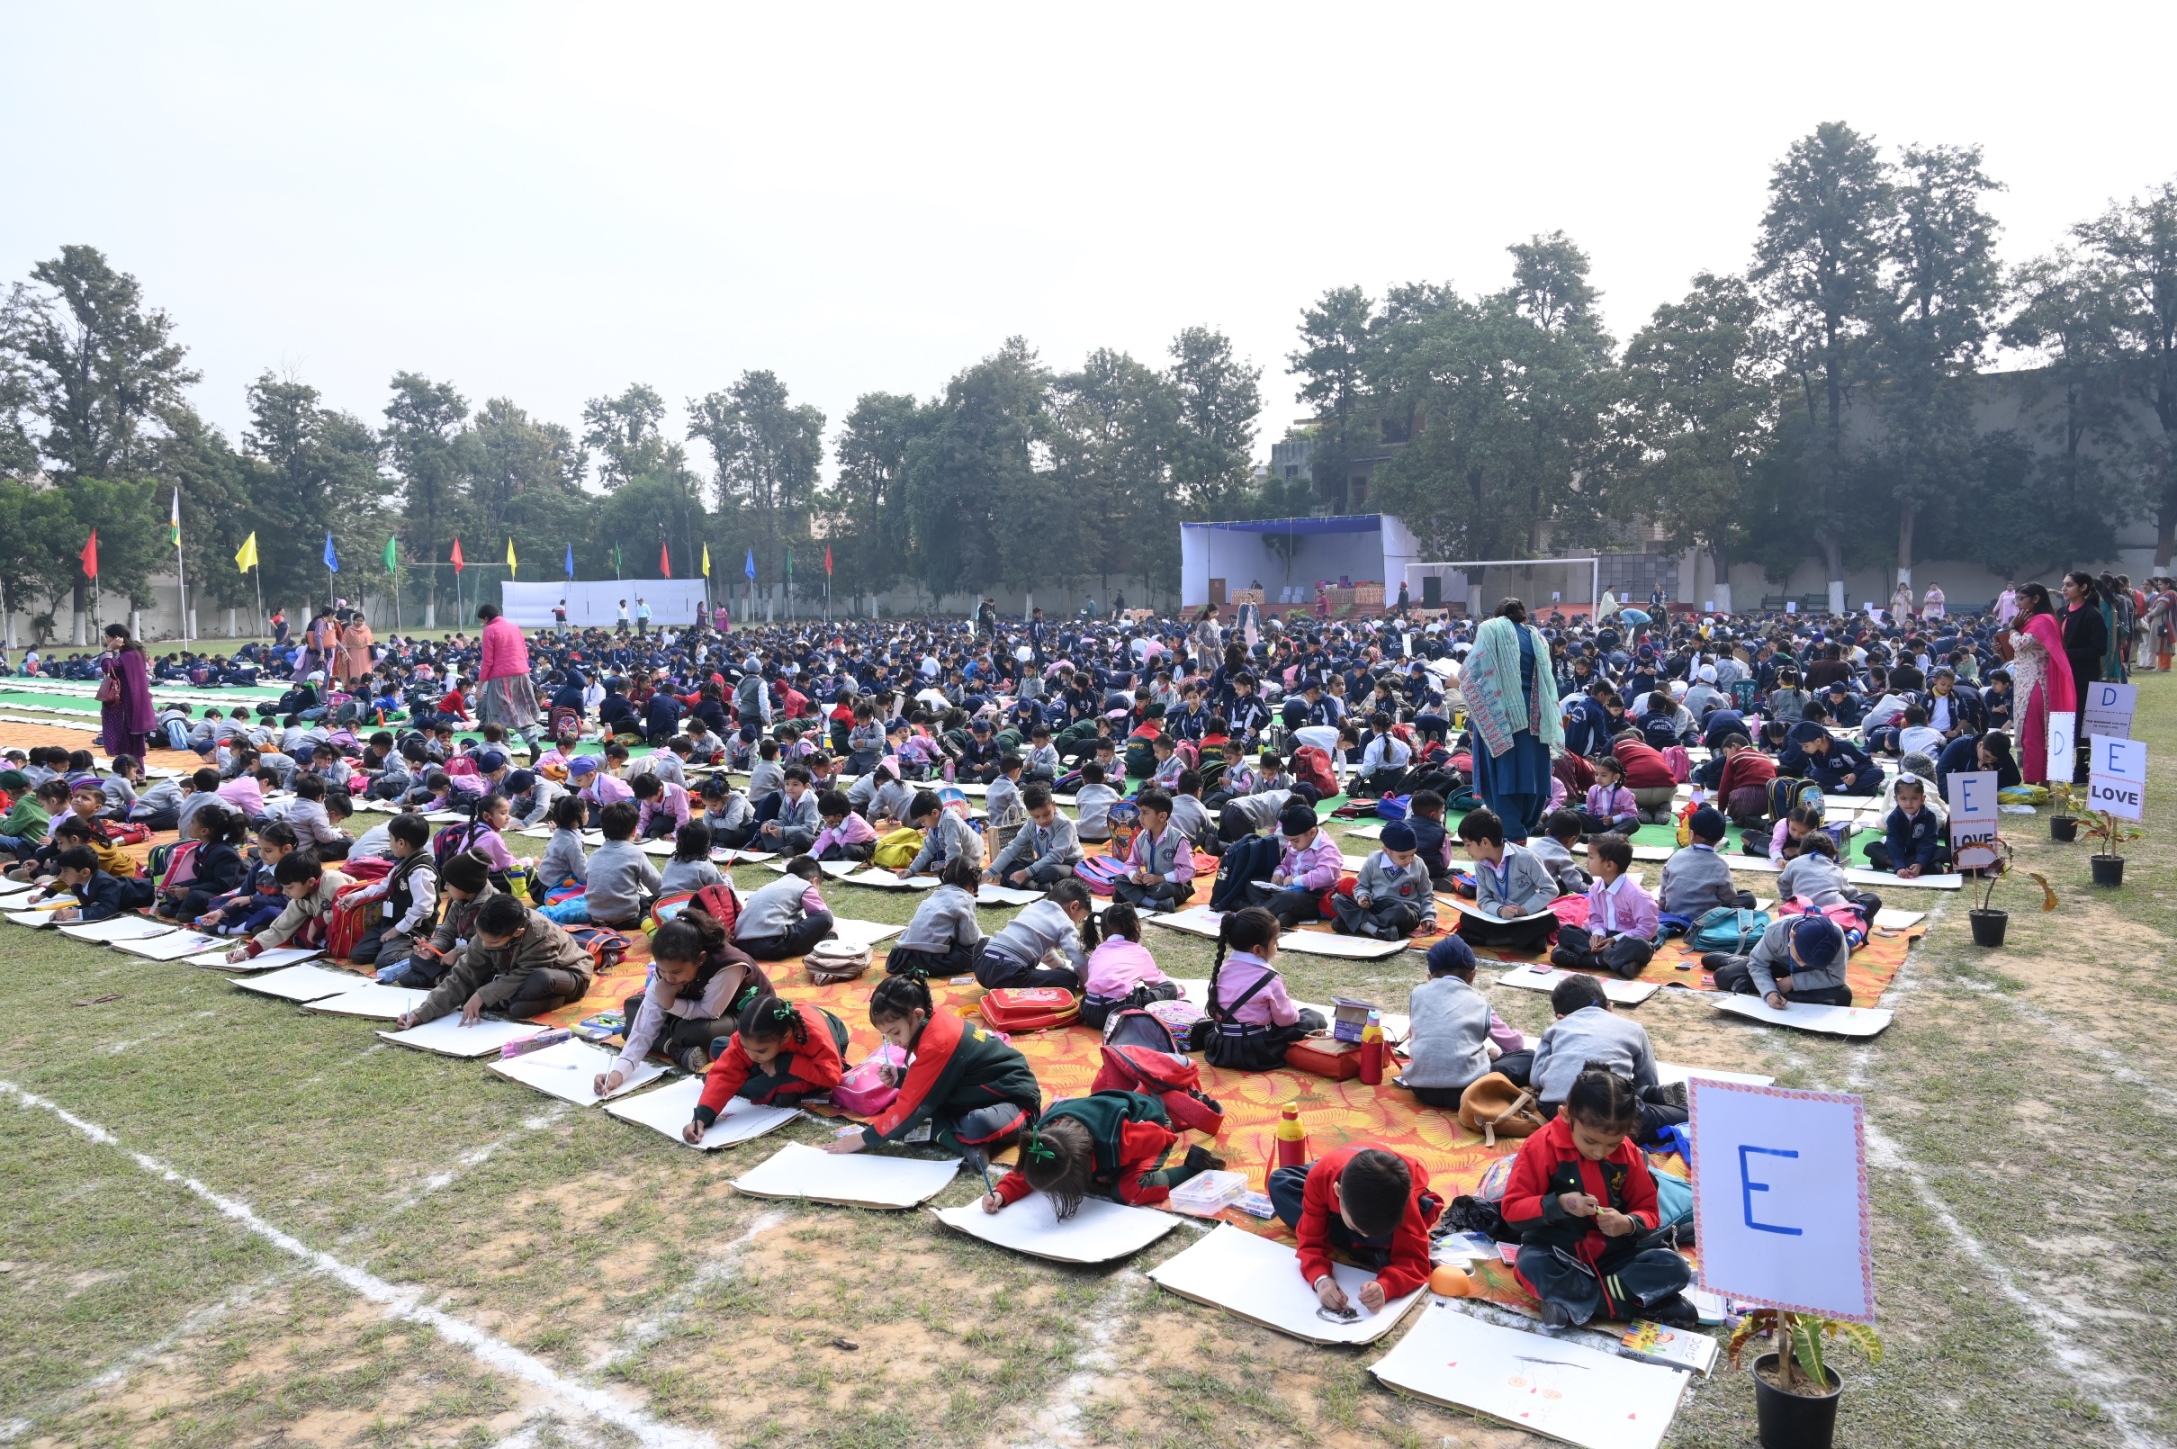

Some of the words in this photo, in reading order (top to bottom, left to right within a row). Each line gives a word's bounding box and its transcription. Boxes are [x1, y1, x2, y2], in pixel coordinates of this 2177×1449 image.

[2102, 687, 2117, 706] D
[2054, 730, 2065, 756] D
[2108, 743, 2126, 773] E
[1963, 780, 1978, 812] E
[2091, 785, 2139, 806] LOVE
[1738, 1144, 1803, 1236] E
